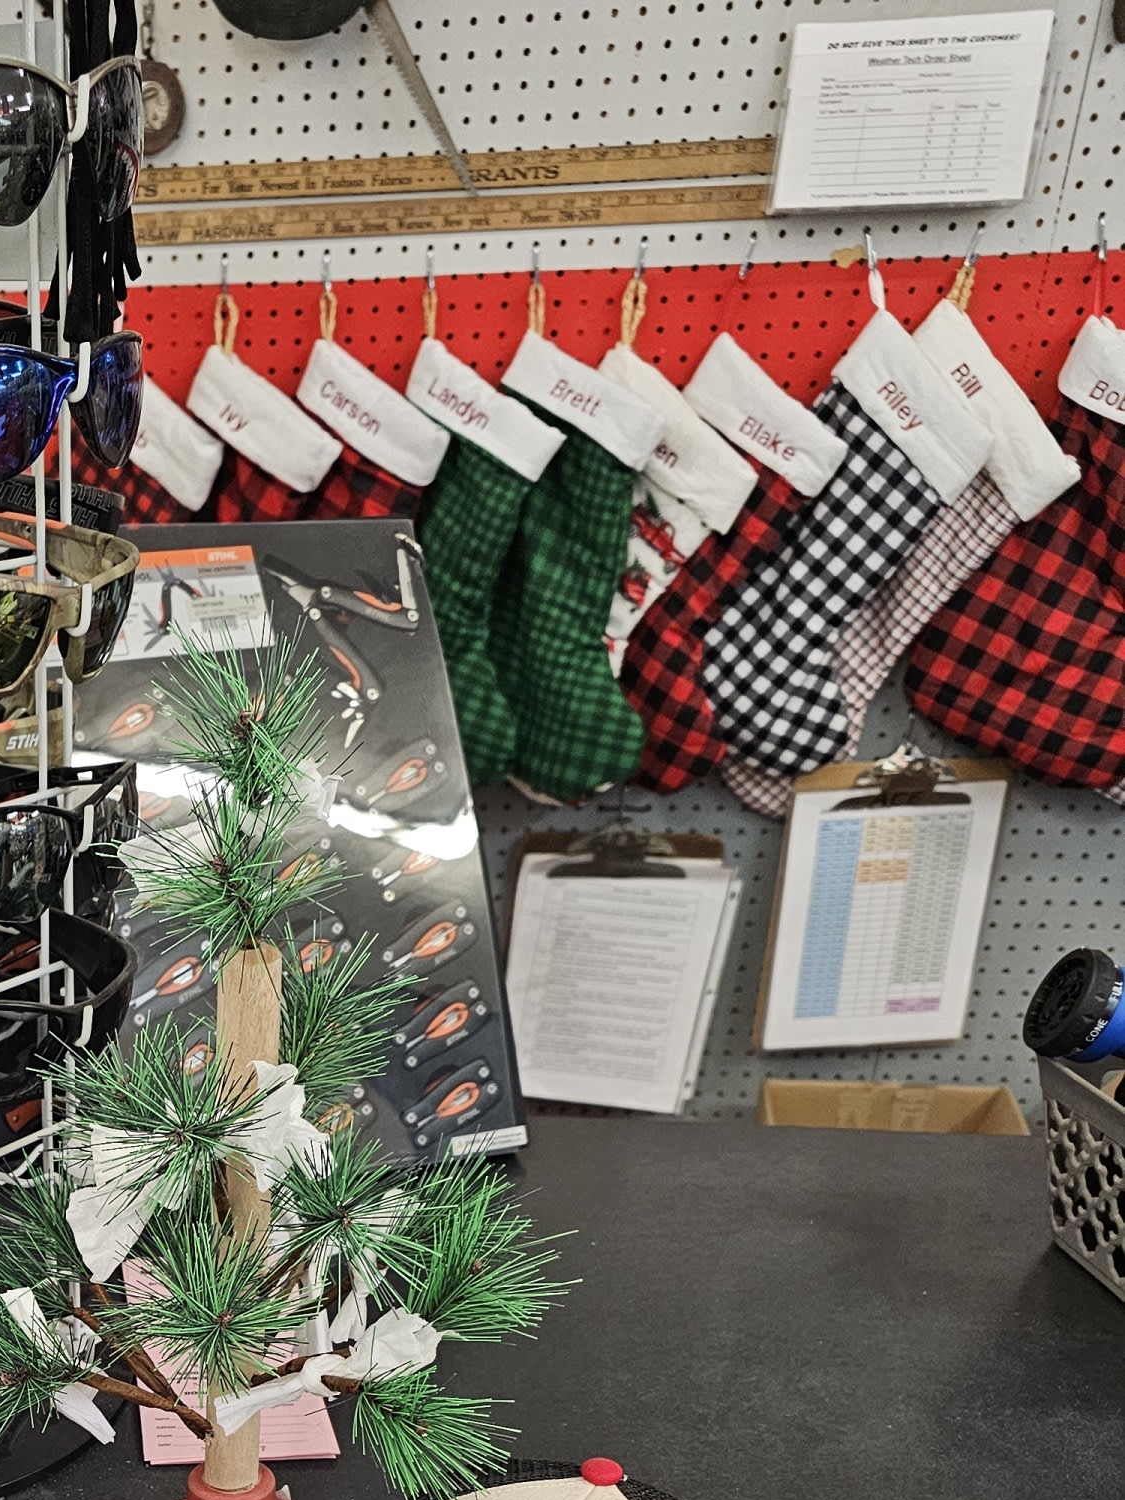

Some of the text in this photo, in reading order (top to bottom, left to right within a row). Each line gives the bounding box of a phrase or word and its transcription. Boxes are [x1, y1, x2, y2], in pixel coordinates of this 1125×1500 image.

[192, 225, 277, 240] HARDWARE
[550, 378, 602, 418] Brett
[951, 361, 982, 399] Bill
[221, 404, 249, 433] Ivy
[320, 380, 381, 435] Carson
[427, 378, 489, 430] Landyn
[876, 380, 924, 433] Riley
[739, 415, 795, 463] Blake
[1085, 1017, 1109, 1042] CONE
